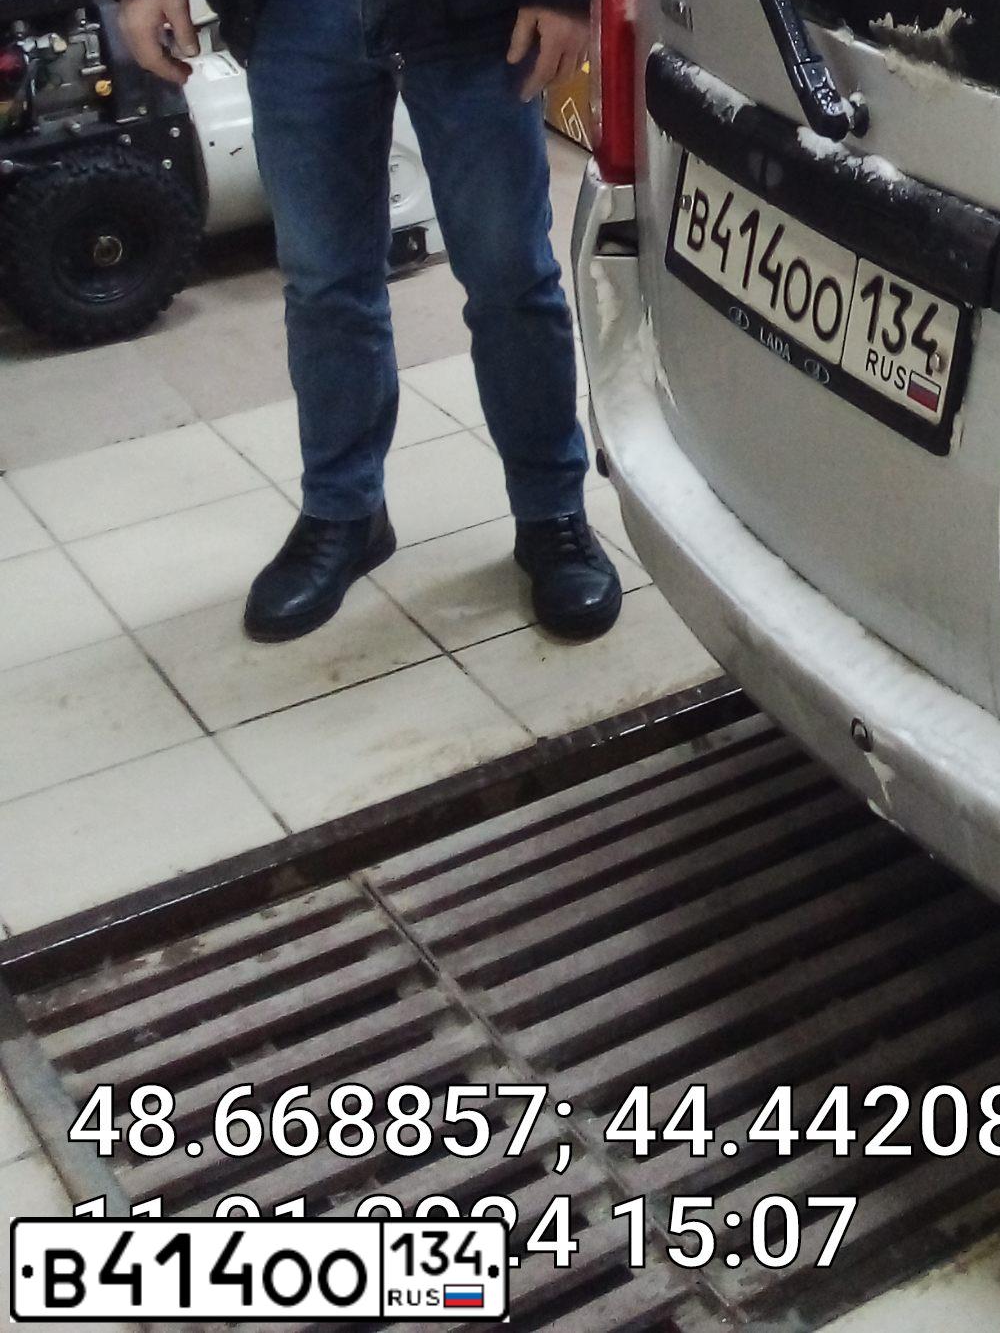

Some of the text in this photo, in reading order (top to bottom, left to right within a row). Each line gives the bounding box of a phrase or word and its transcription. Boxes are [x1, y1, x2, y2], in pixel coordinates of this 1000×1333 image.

[760, 327, 791, 363] LADA
[860, 274, 941, 376] 134
[865, 349, 908, 391] RUS
